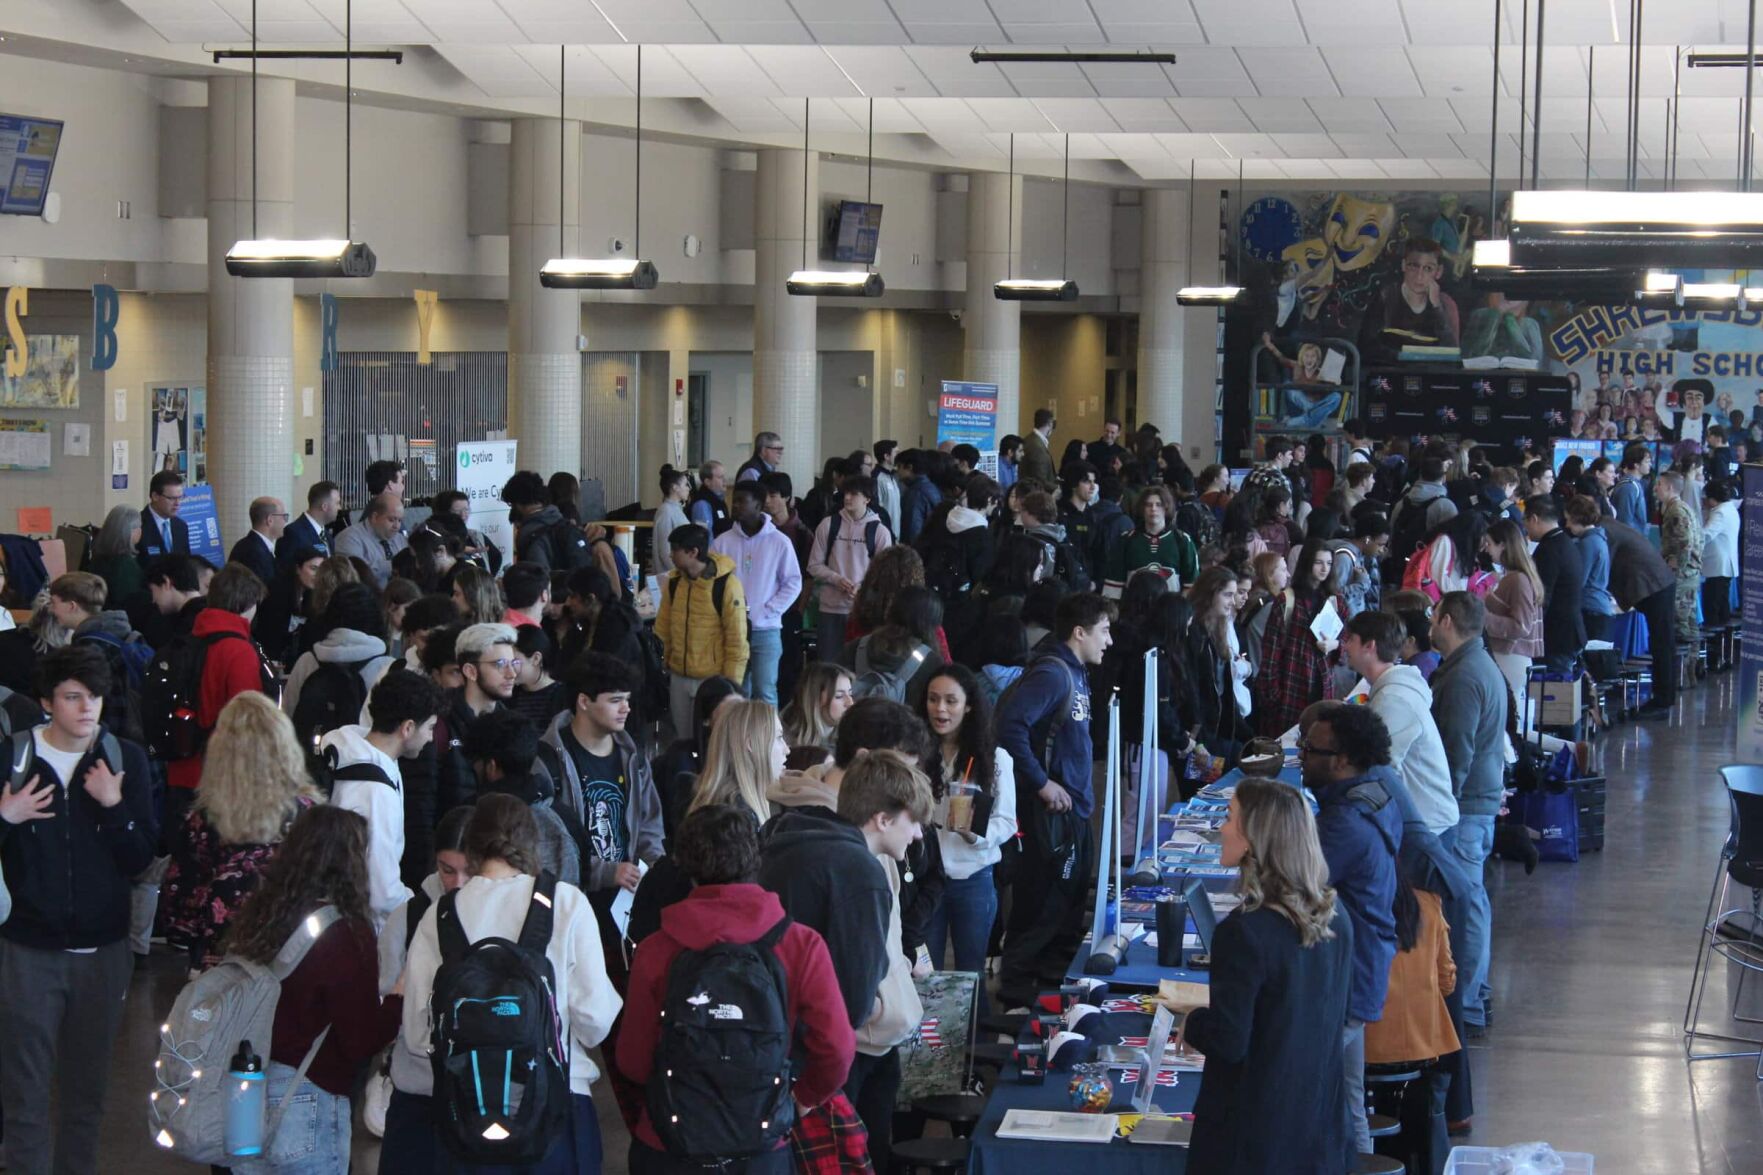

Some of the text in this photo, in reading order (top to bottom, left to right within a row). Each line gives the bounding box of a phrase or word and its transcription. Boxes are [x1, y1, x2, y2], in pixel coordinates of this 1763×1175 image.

[5, 283, 438, 378] S B R Y
[1597, 350, 1674, 375] HIGH
[943, 397, 993, 411] LIFEGUARD
[472, 450, 493, 464] cytiva
[478, 489, 488, 498] are
